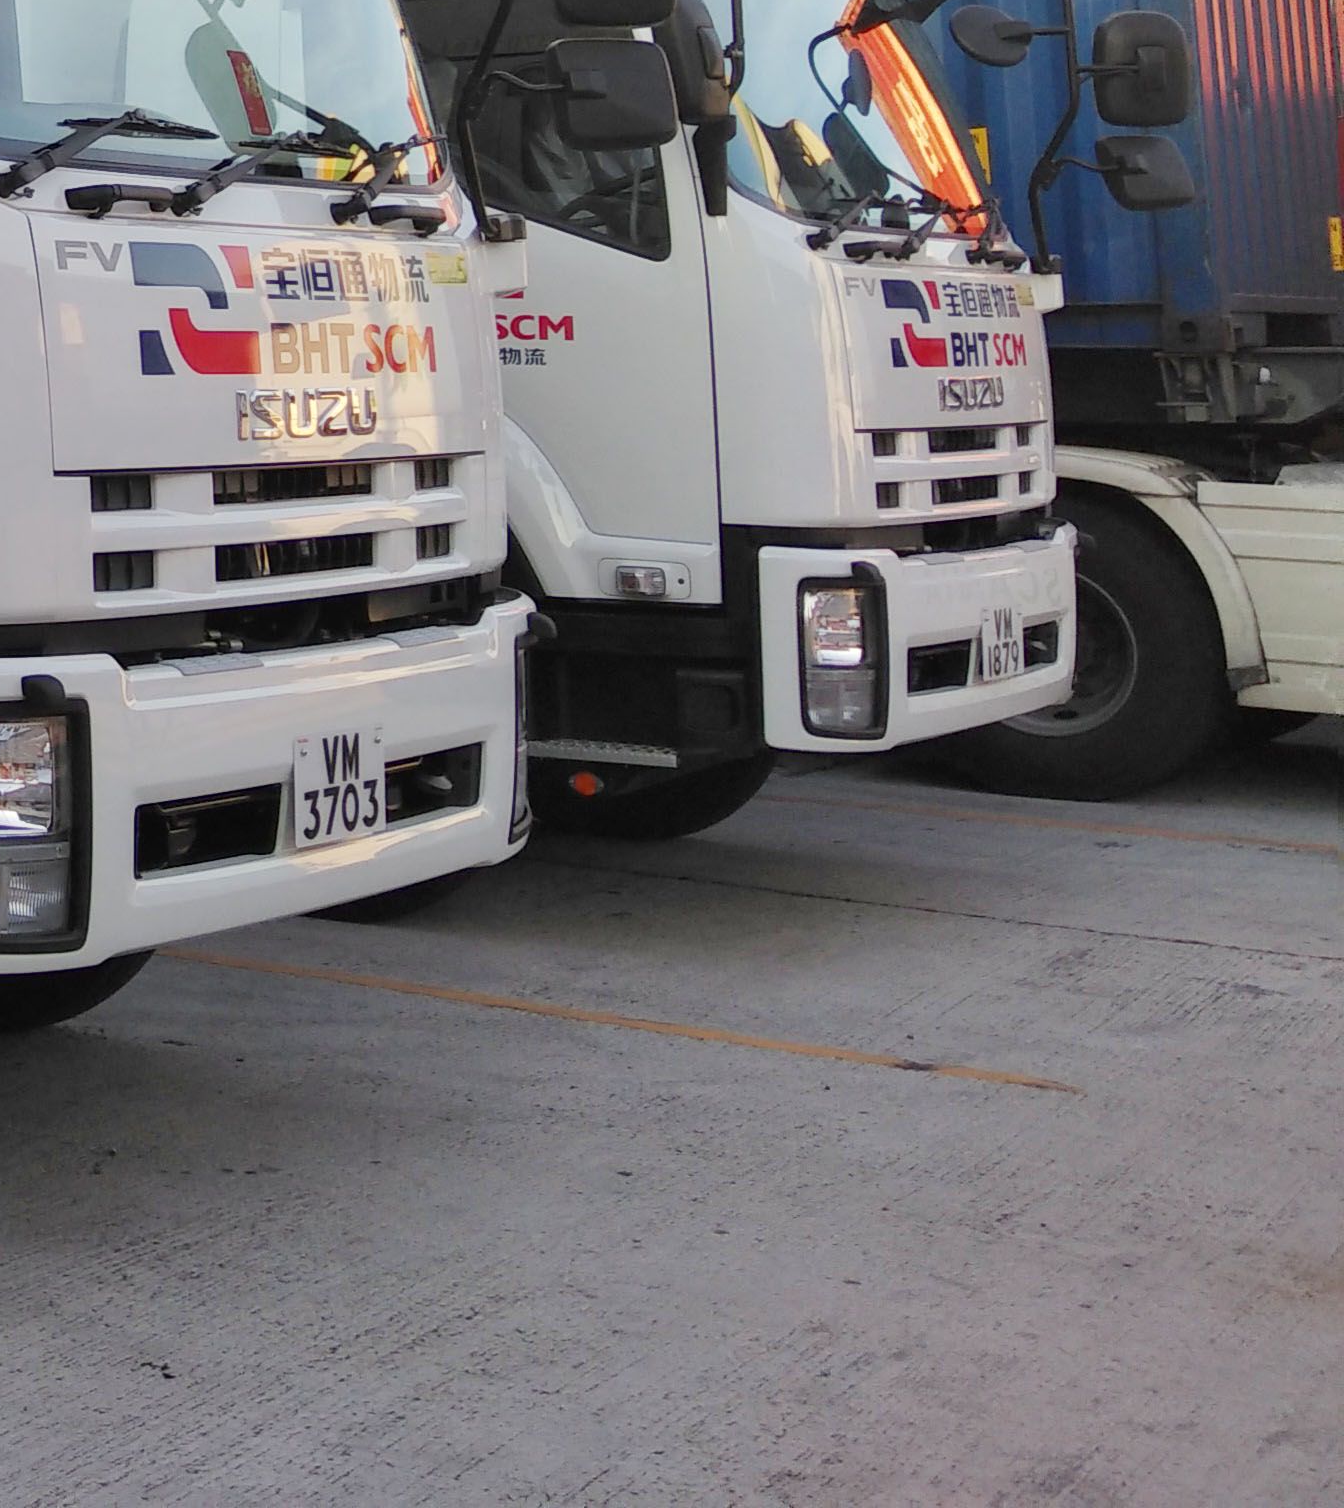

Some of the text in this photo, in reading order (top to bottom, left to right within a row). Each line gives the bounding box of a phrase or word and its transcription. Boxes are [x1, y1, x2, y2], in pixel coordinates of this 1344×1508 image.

[54, 239, 123, 273] FV
[260, 247, 430, 304] 宝恒通物流
[942, 282, 1021, 318] 宝恒通物流
[494, 313, 574, 341] SCM
[270, 323, 437, 375] BHT SCM
[498, 347, 547, 366] 物流
[950, 332, 1028, 368] BHT SCM
[937, 374, 1005, 412] ISUZU
[234, 386, 378, 442] ISUZU
[993, 607, 1013, 641] VM
[987, 639, 1020, 677] 1879
[322, 732, 361, 785] VM
[303, 779, 379, 840] 3703
